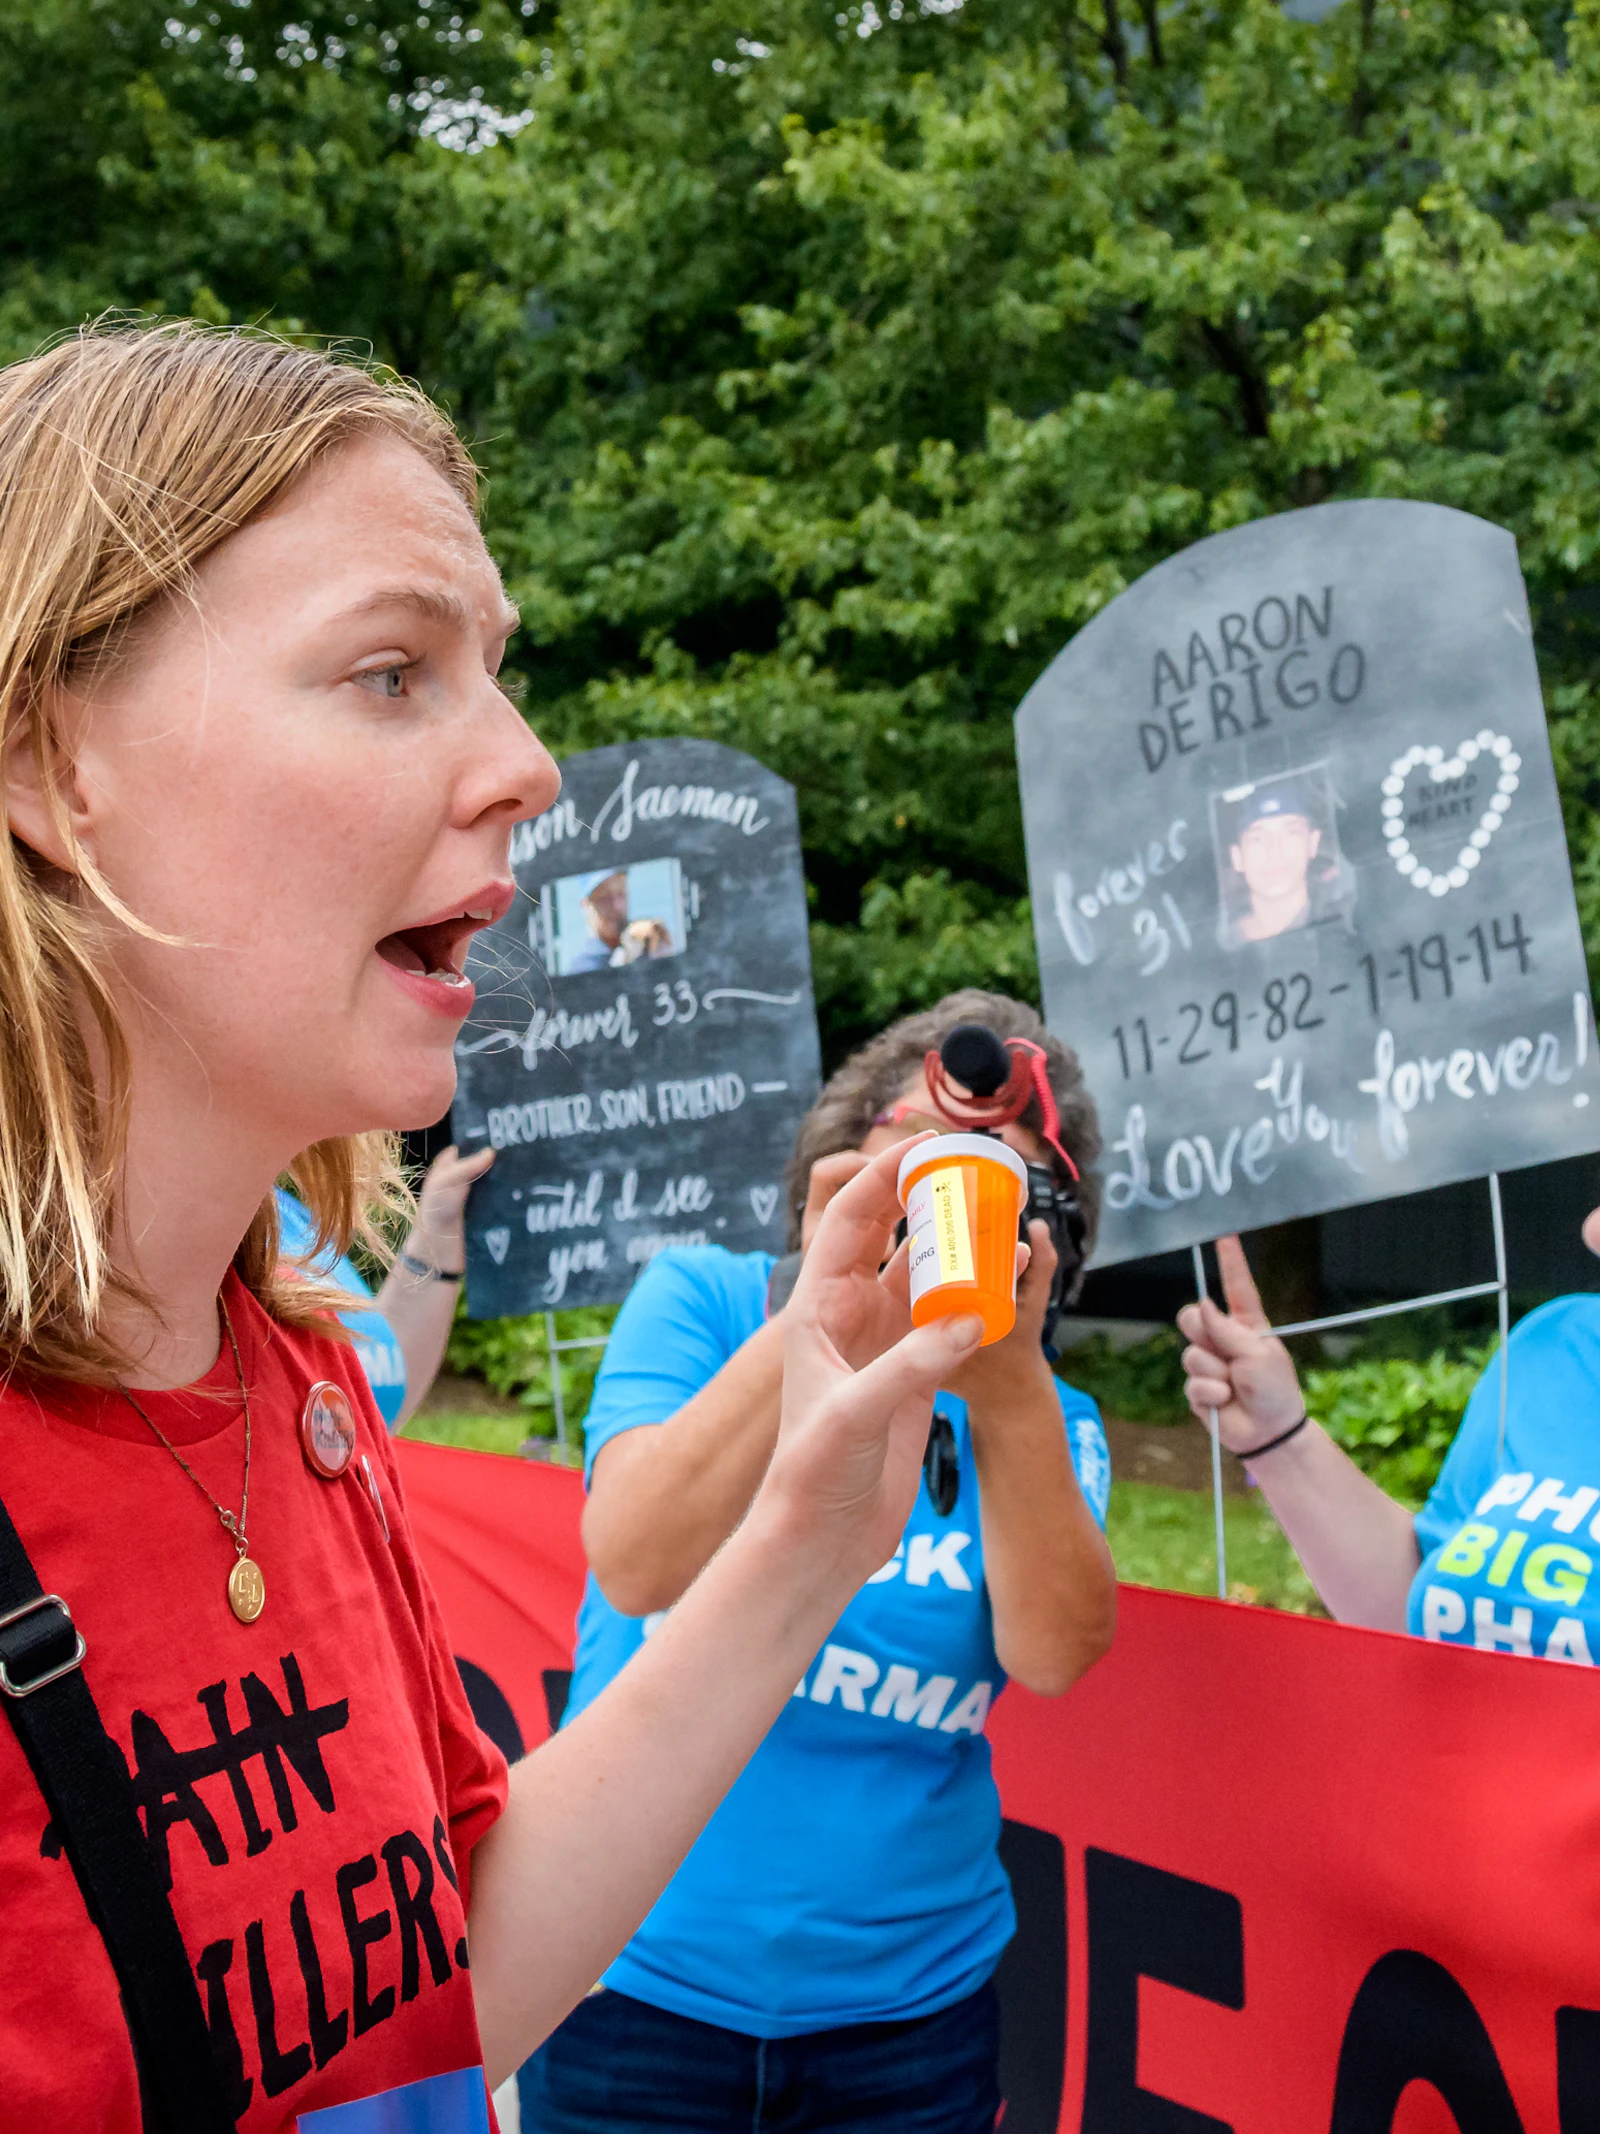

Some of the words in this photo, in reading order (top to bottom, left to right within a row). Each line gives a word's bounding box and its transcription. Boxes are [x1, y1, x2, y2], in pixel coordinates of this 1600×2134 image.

[1153, 586, 1334, 706] AARON
[509, 799, 583, 866] son
[1133, 892, 1193, 976] 31
[651, 979, 699, 1026] 33
[1106, 1105, 1275, 1209] Love
[526, 1169, 604, 1234] until
[650, 1174, 714, 1216] see
[943, 1194, 953, 1219] DEAD
[540, 1237, 608, 1305] you
[1436, 1523, 1593, 1607] BIG
[794, 1643, 992, 1735] RMA
[40, 1652, 350, 1893] AIN
